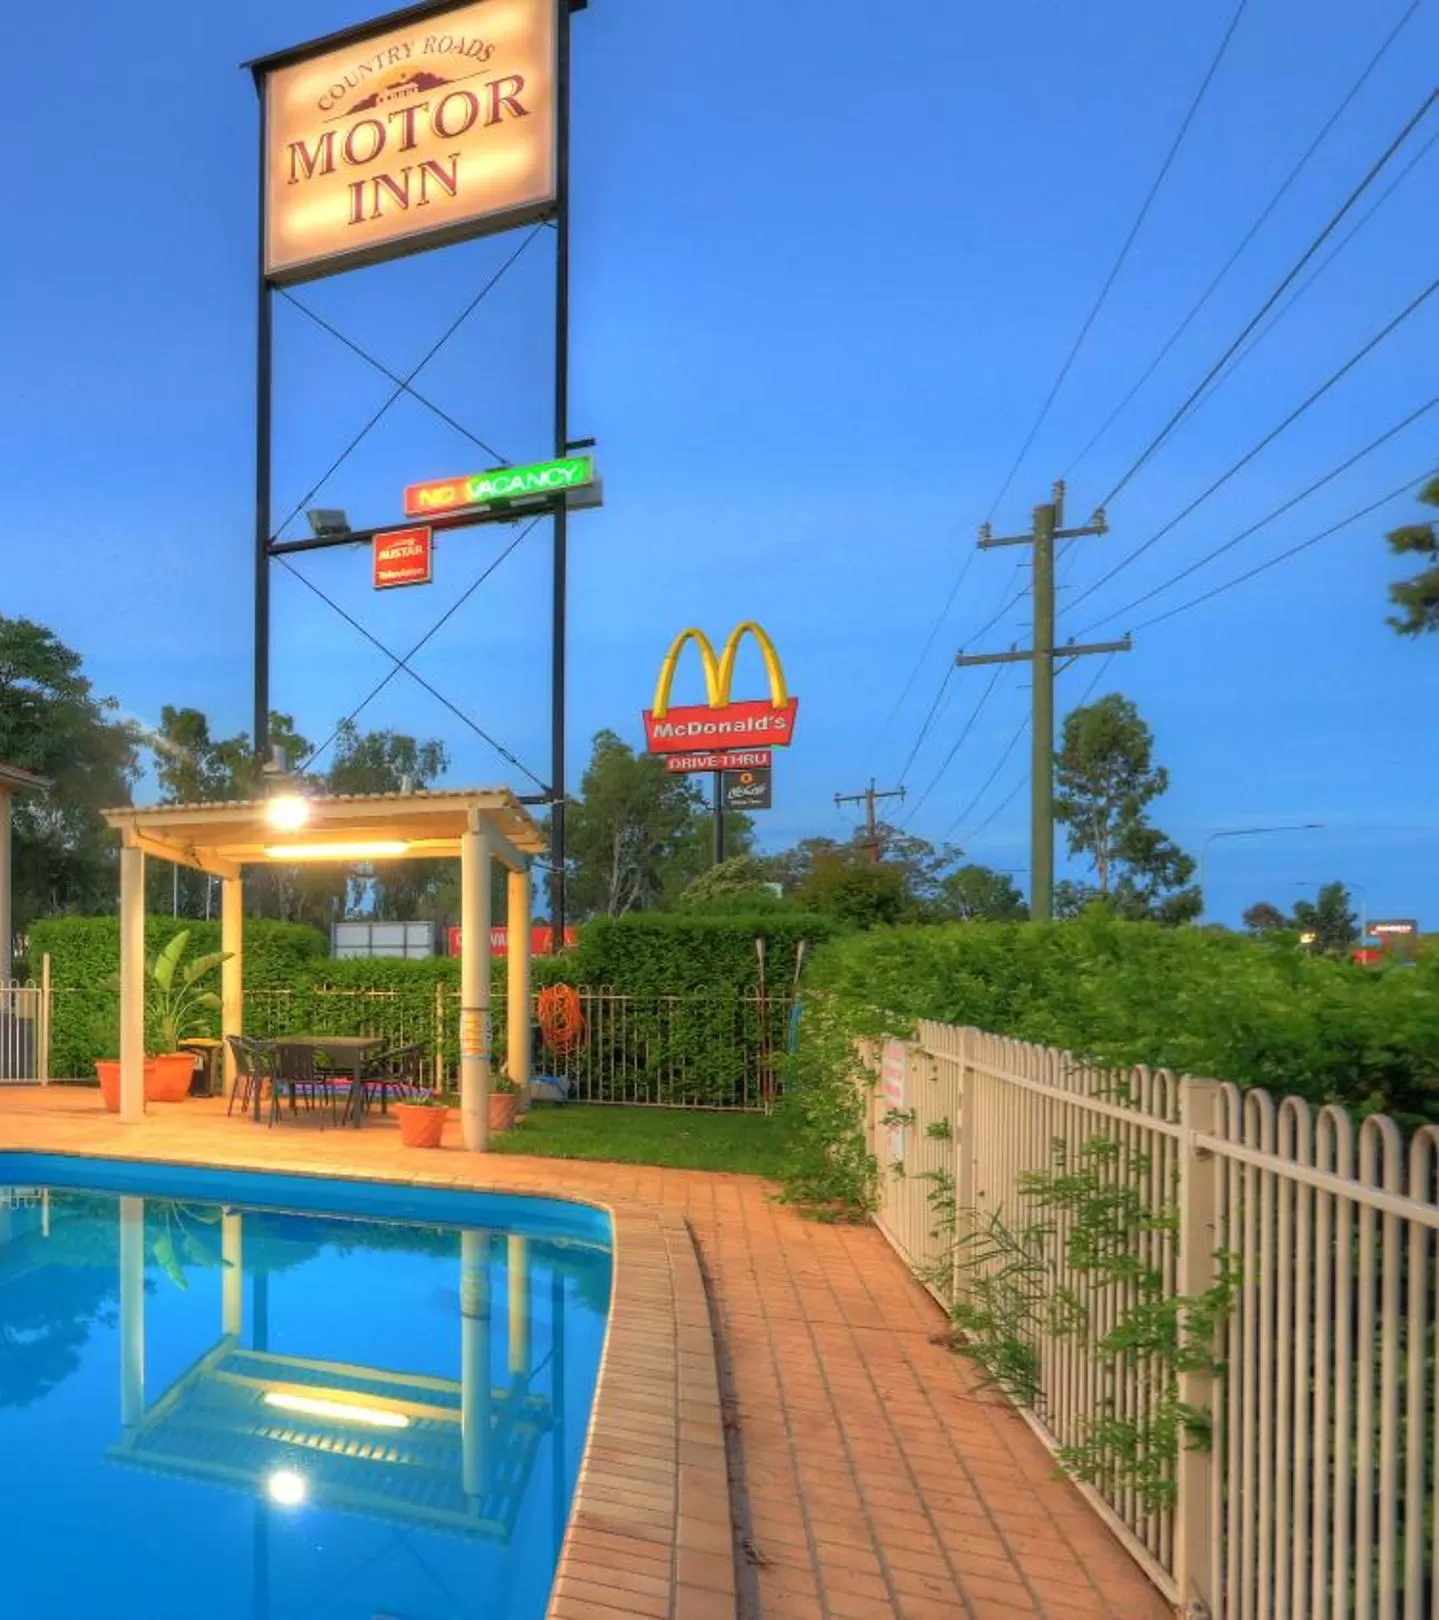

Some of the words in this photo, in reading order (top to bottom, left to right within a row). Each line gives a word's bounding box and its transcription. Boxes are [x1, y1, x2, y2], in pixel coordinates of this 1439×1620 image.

[317, 42, 414, 112] COUNTRY
[423, 35, 496, 63] ROADS
[286, 74, 531, 185] MOTOR
[347, 153, 461, 225] INN
[418, 486, 456, 507] NO
[465, 465, 578, 500] VACANCY
[378, 545, 423, 561] AUSTAR
[653, 716, 787, 738] McDonald's
